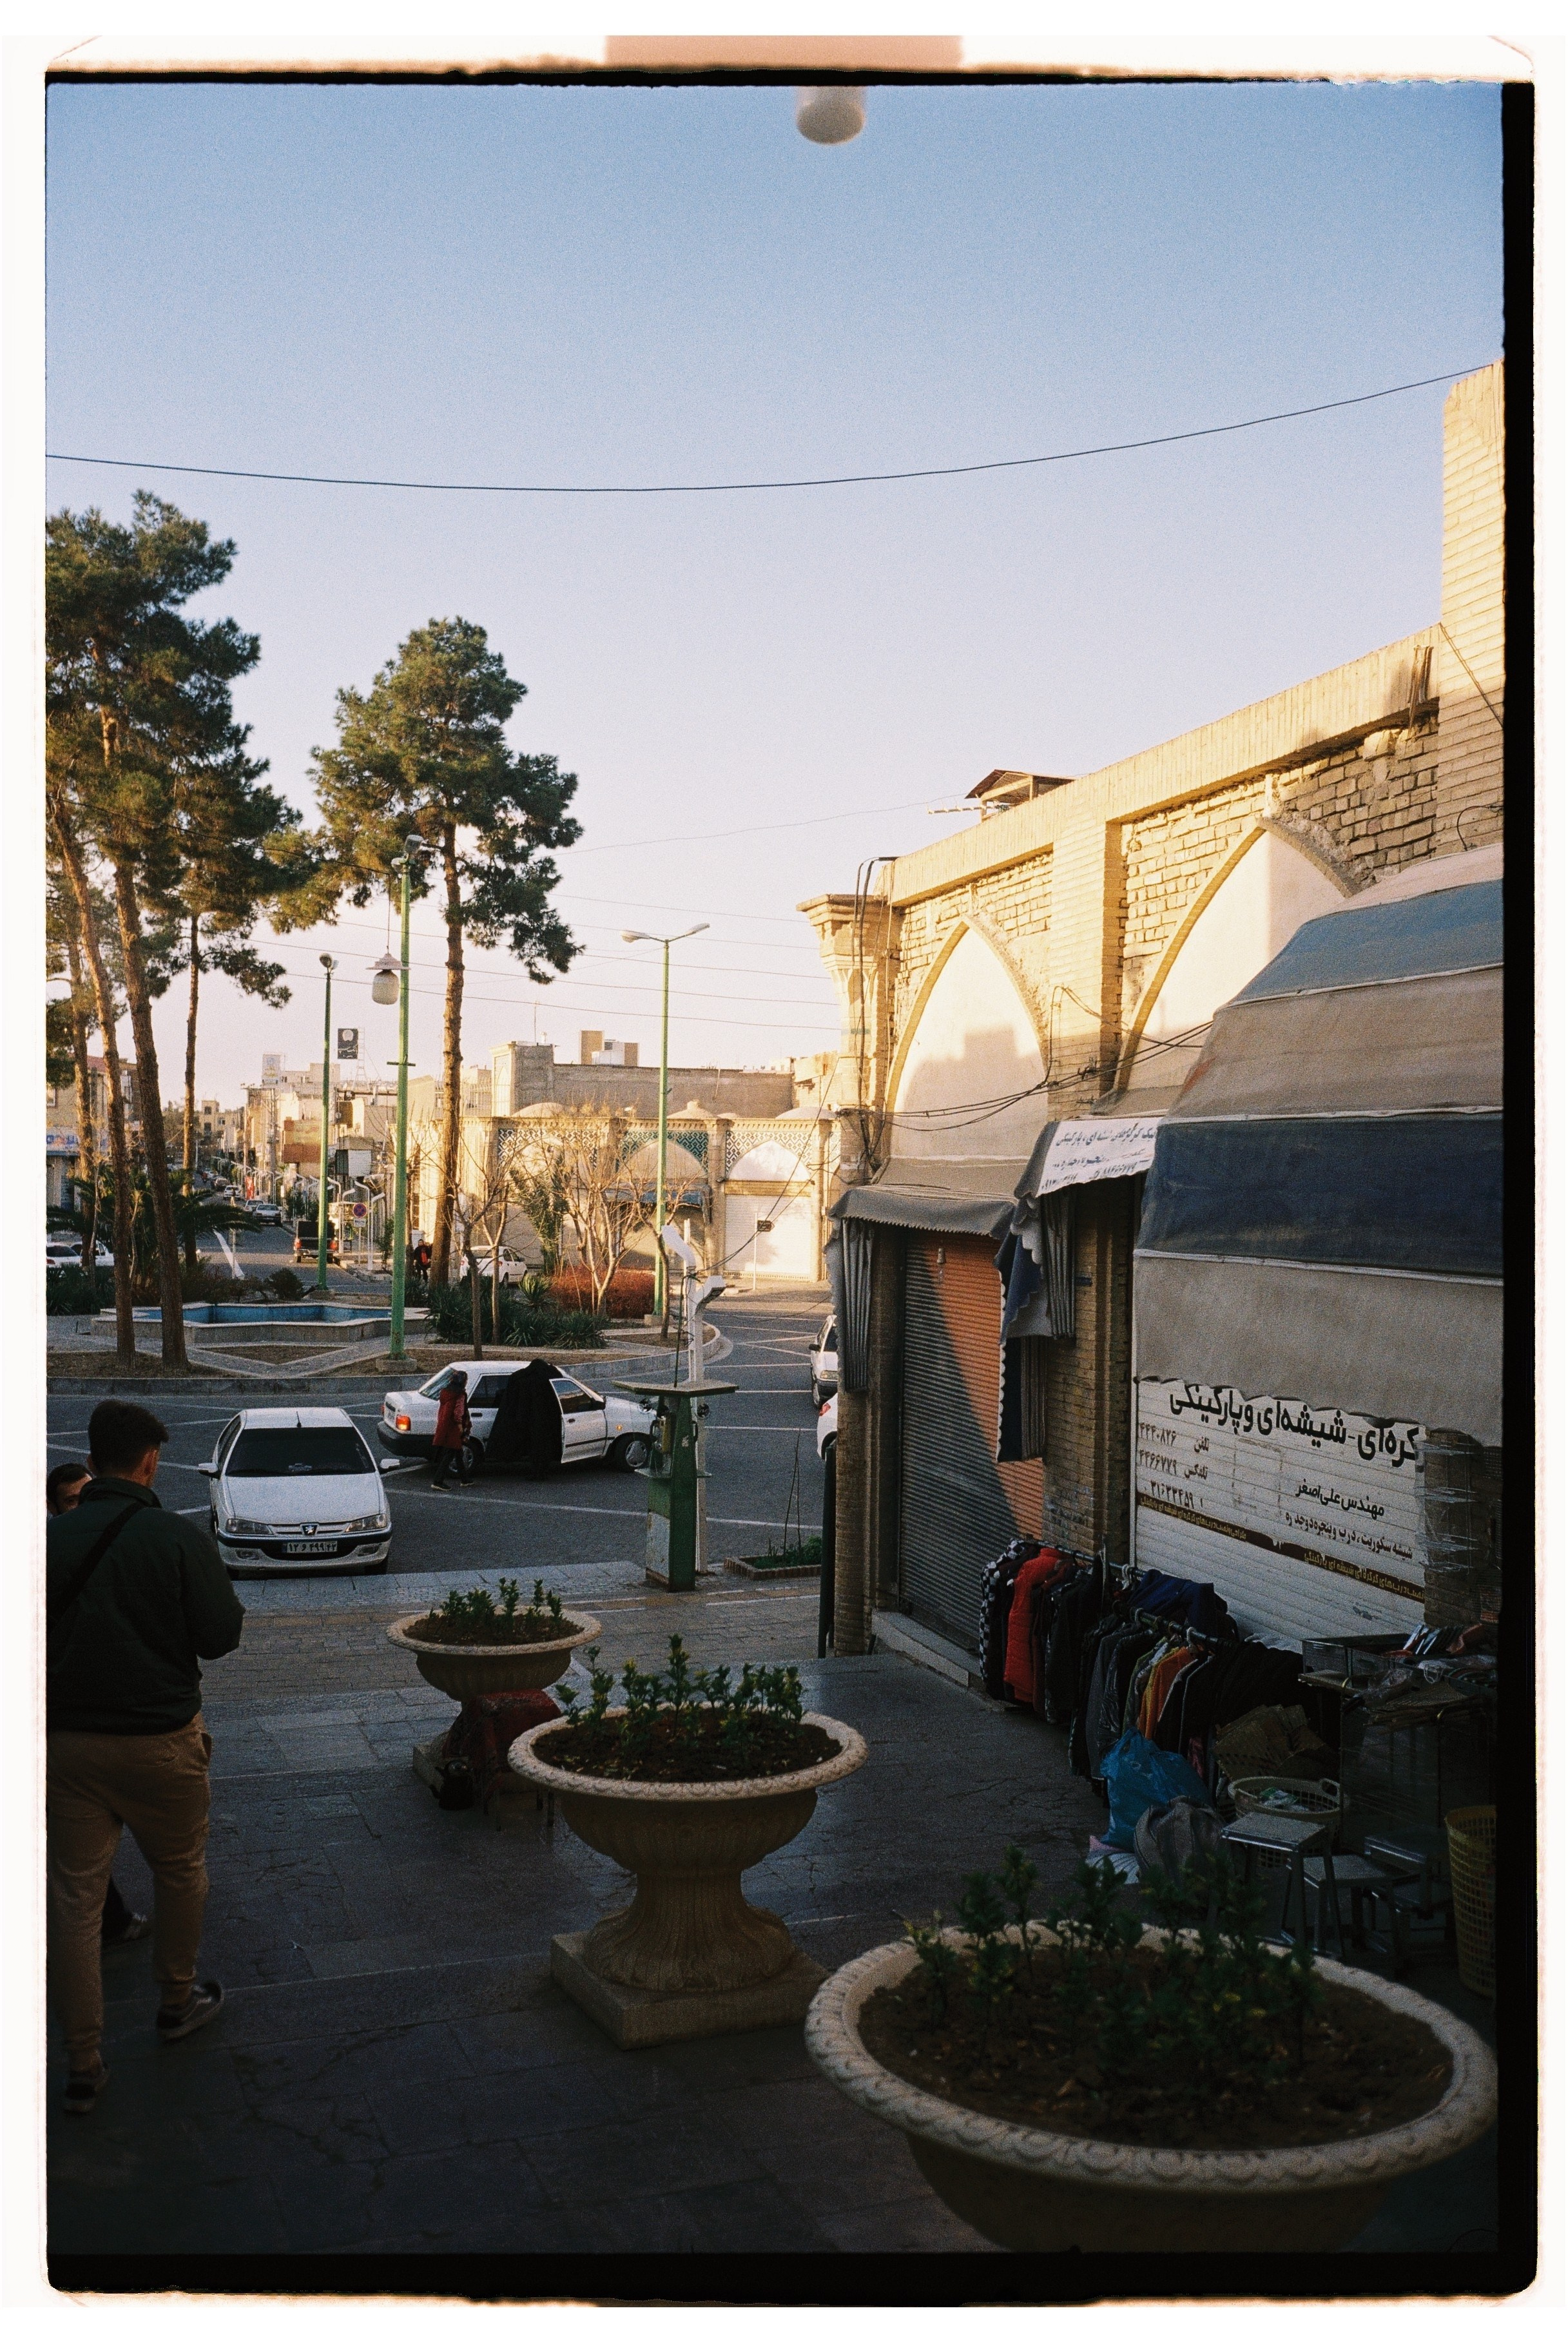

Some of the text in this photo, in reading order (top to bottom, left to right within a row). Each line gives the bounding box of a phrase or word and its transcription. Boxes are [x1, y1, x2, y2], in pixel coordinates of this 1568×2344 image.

[1194, 1437, 1210, 1453] تلفن
[1139, 1449, 1177, 1475] ۴۴۶۶۷۷۹
[1295, 1478, 1384, 1520] مهندس علی اصغر
[1339, 1530, 1357, 1544] درب
